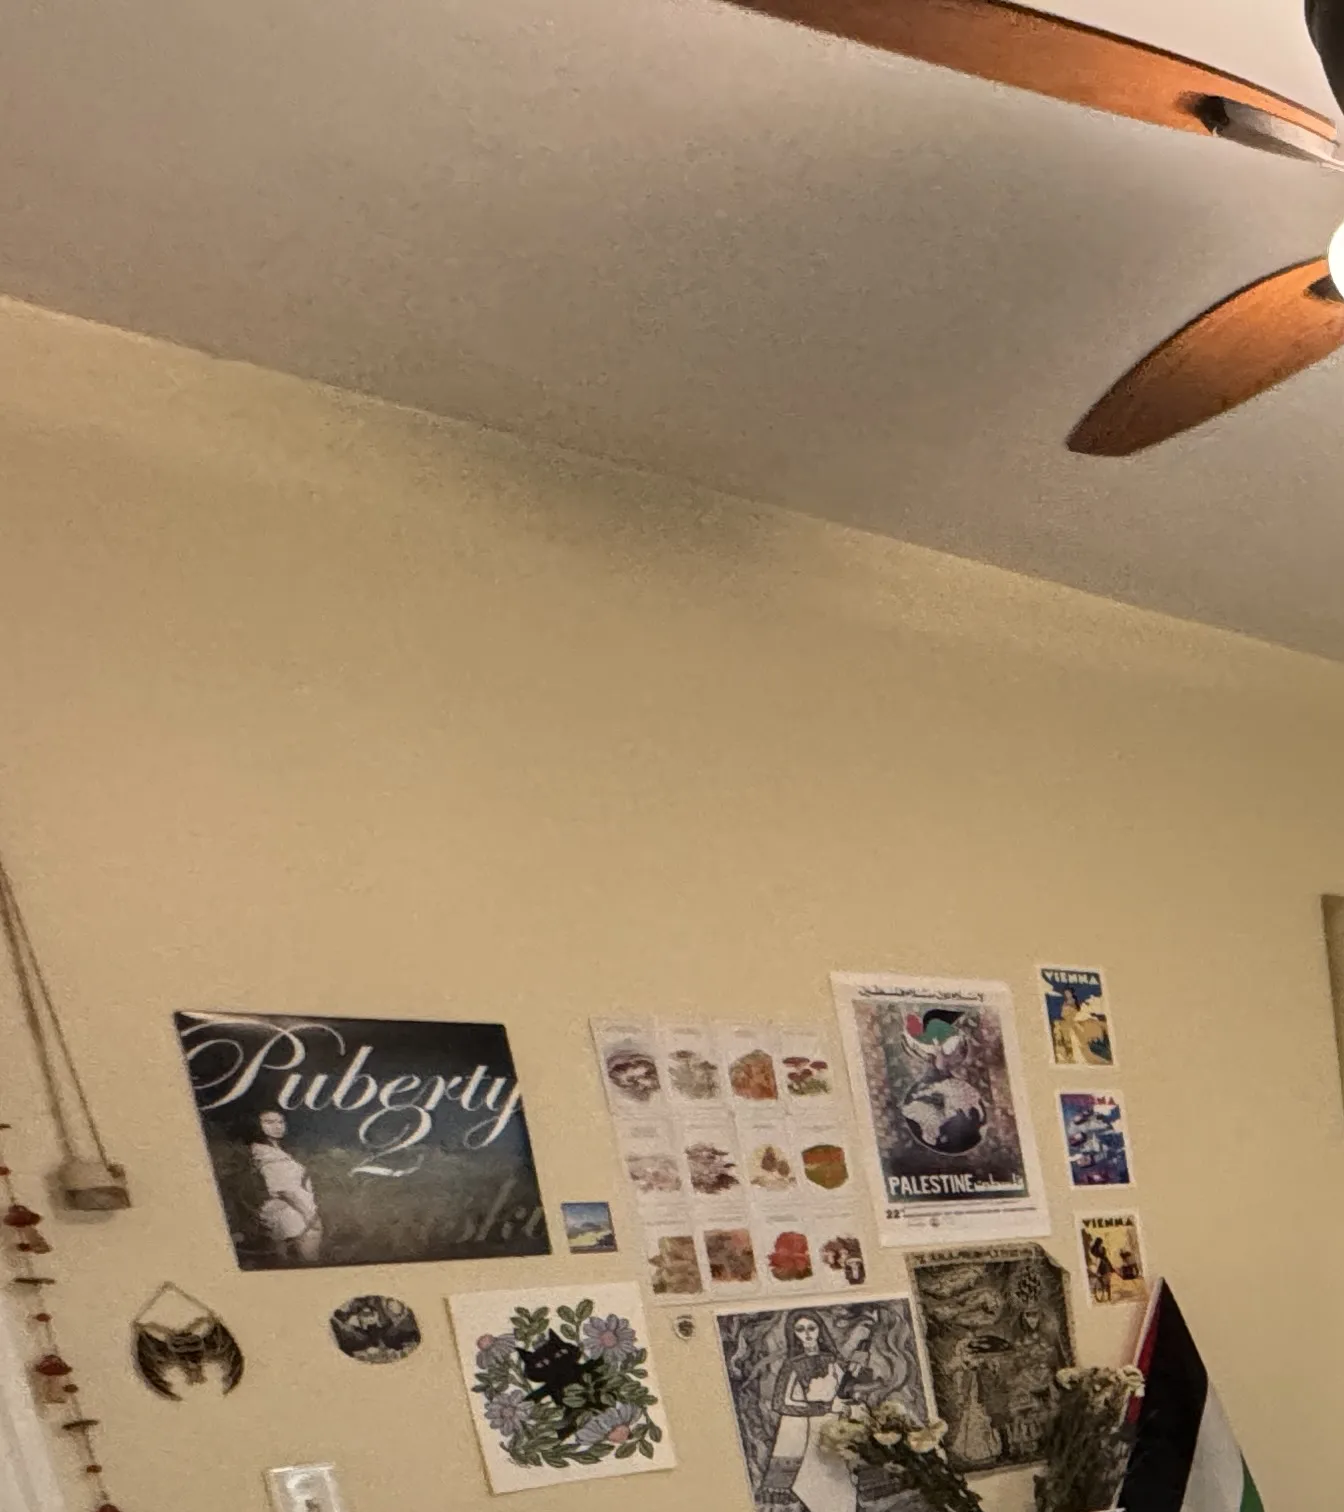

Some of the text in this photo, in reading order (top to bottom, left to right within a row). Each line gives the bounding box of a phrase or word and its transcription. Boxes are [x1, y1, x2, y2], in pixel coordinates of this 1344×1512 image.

[1044, 970, 1100, 986] VIENNA
[180, 1018, 523, 1149] Puberty
[350, 1104, 433, 1178] 2
[888, 1173, 974, 1196] PALESTINE
[1082, 1216, 1134, 1229] VIENNA
